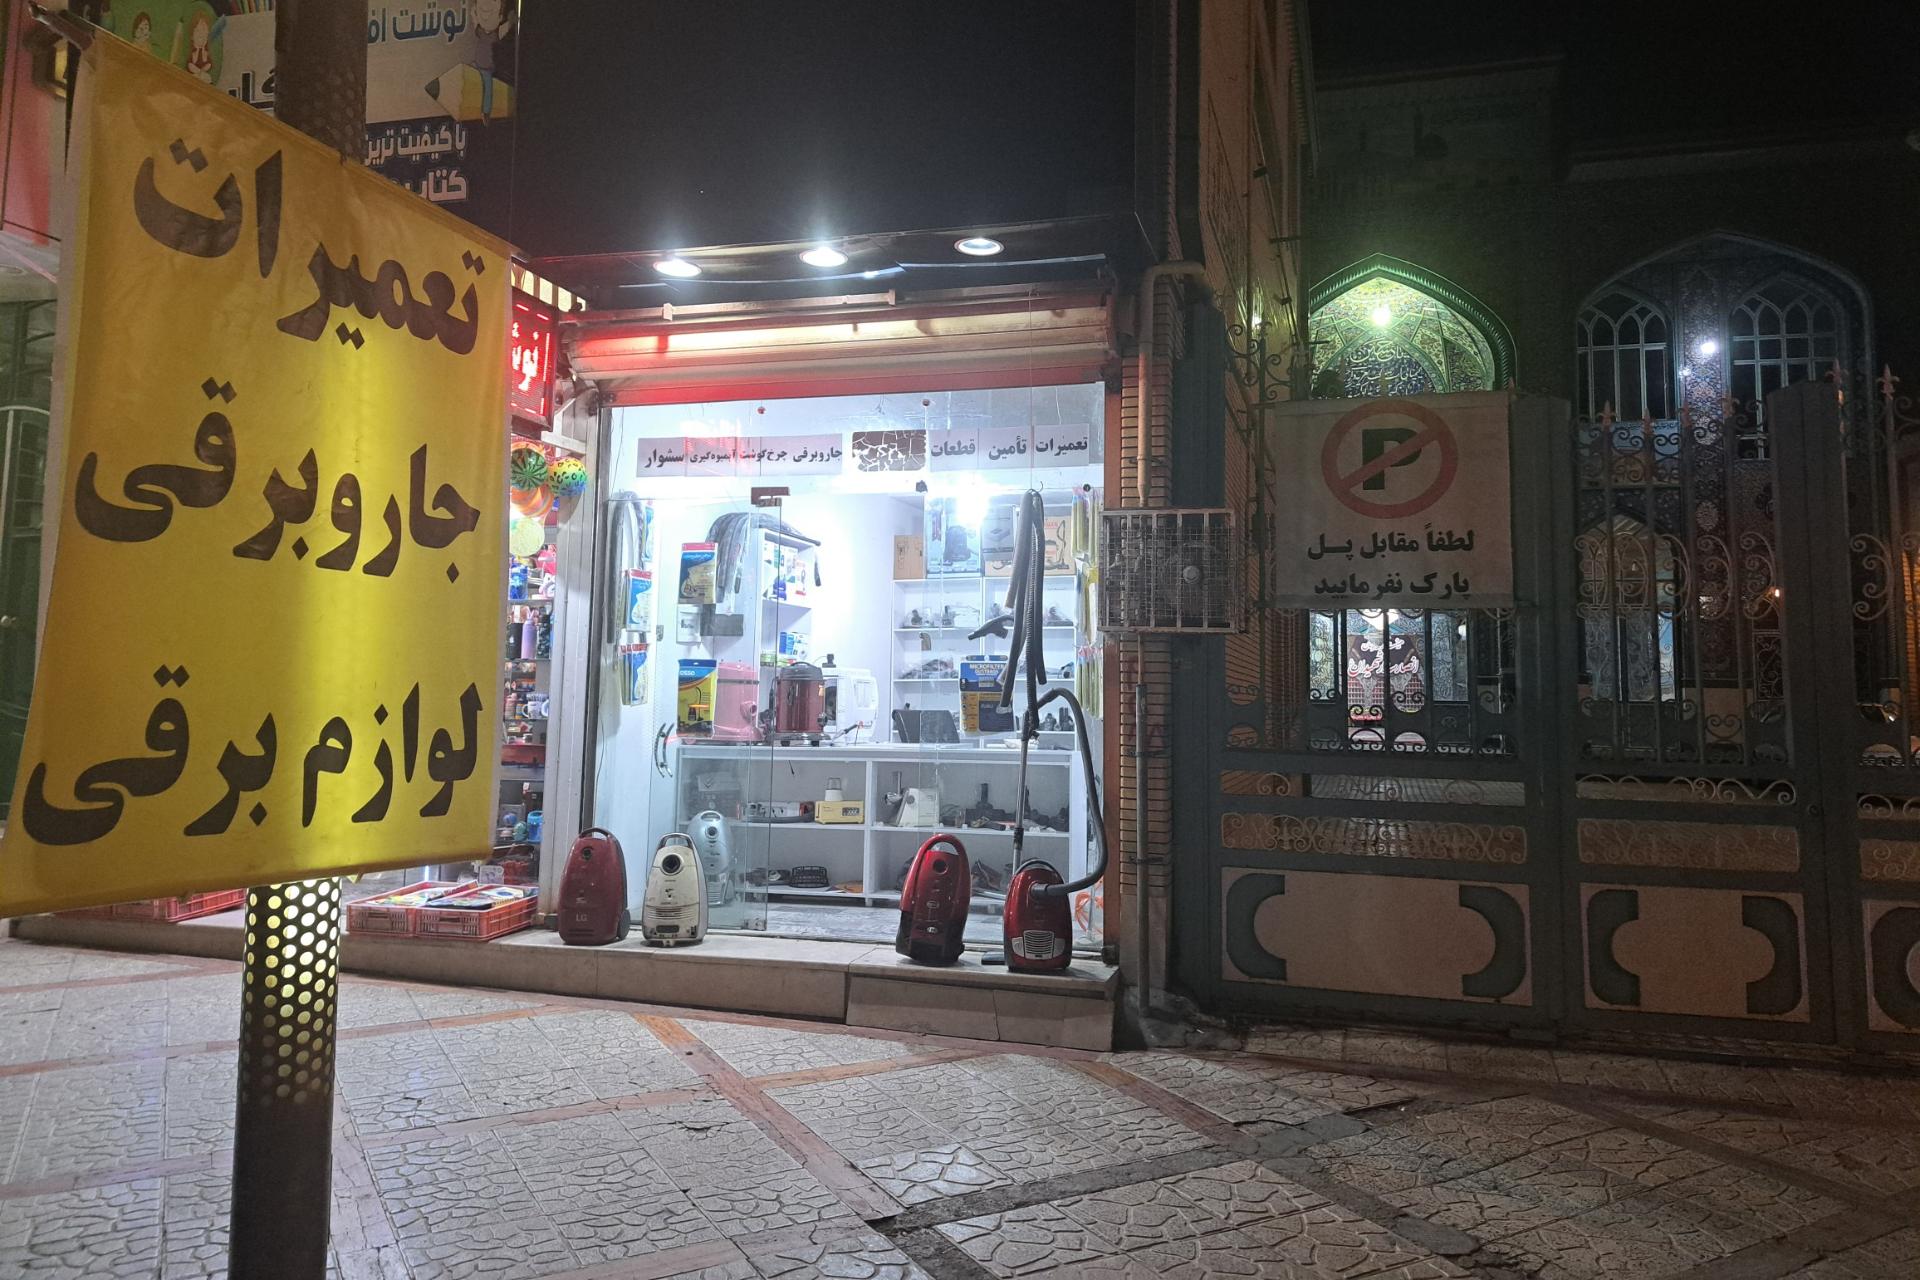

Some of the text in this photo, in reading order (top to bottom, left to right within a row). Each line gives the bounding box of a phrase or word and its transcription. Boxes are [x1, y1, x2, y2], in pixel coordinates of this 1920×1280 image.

[133, 137, 486, 356] تعمیرات
[644, 447, 685, 469] سشوار
[930, 438, 977, 457] قطعات
[1035, 435, 1089, 457] تعمیرات
[1361, 428, 1422, 490] P
[1359, 531, 1420, 559] مقابل
[1409, 571, 1471, 599] پارک
[22, 665, 484, 846] لوازم برقی
[575, 913, 588, 922] LG
